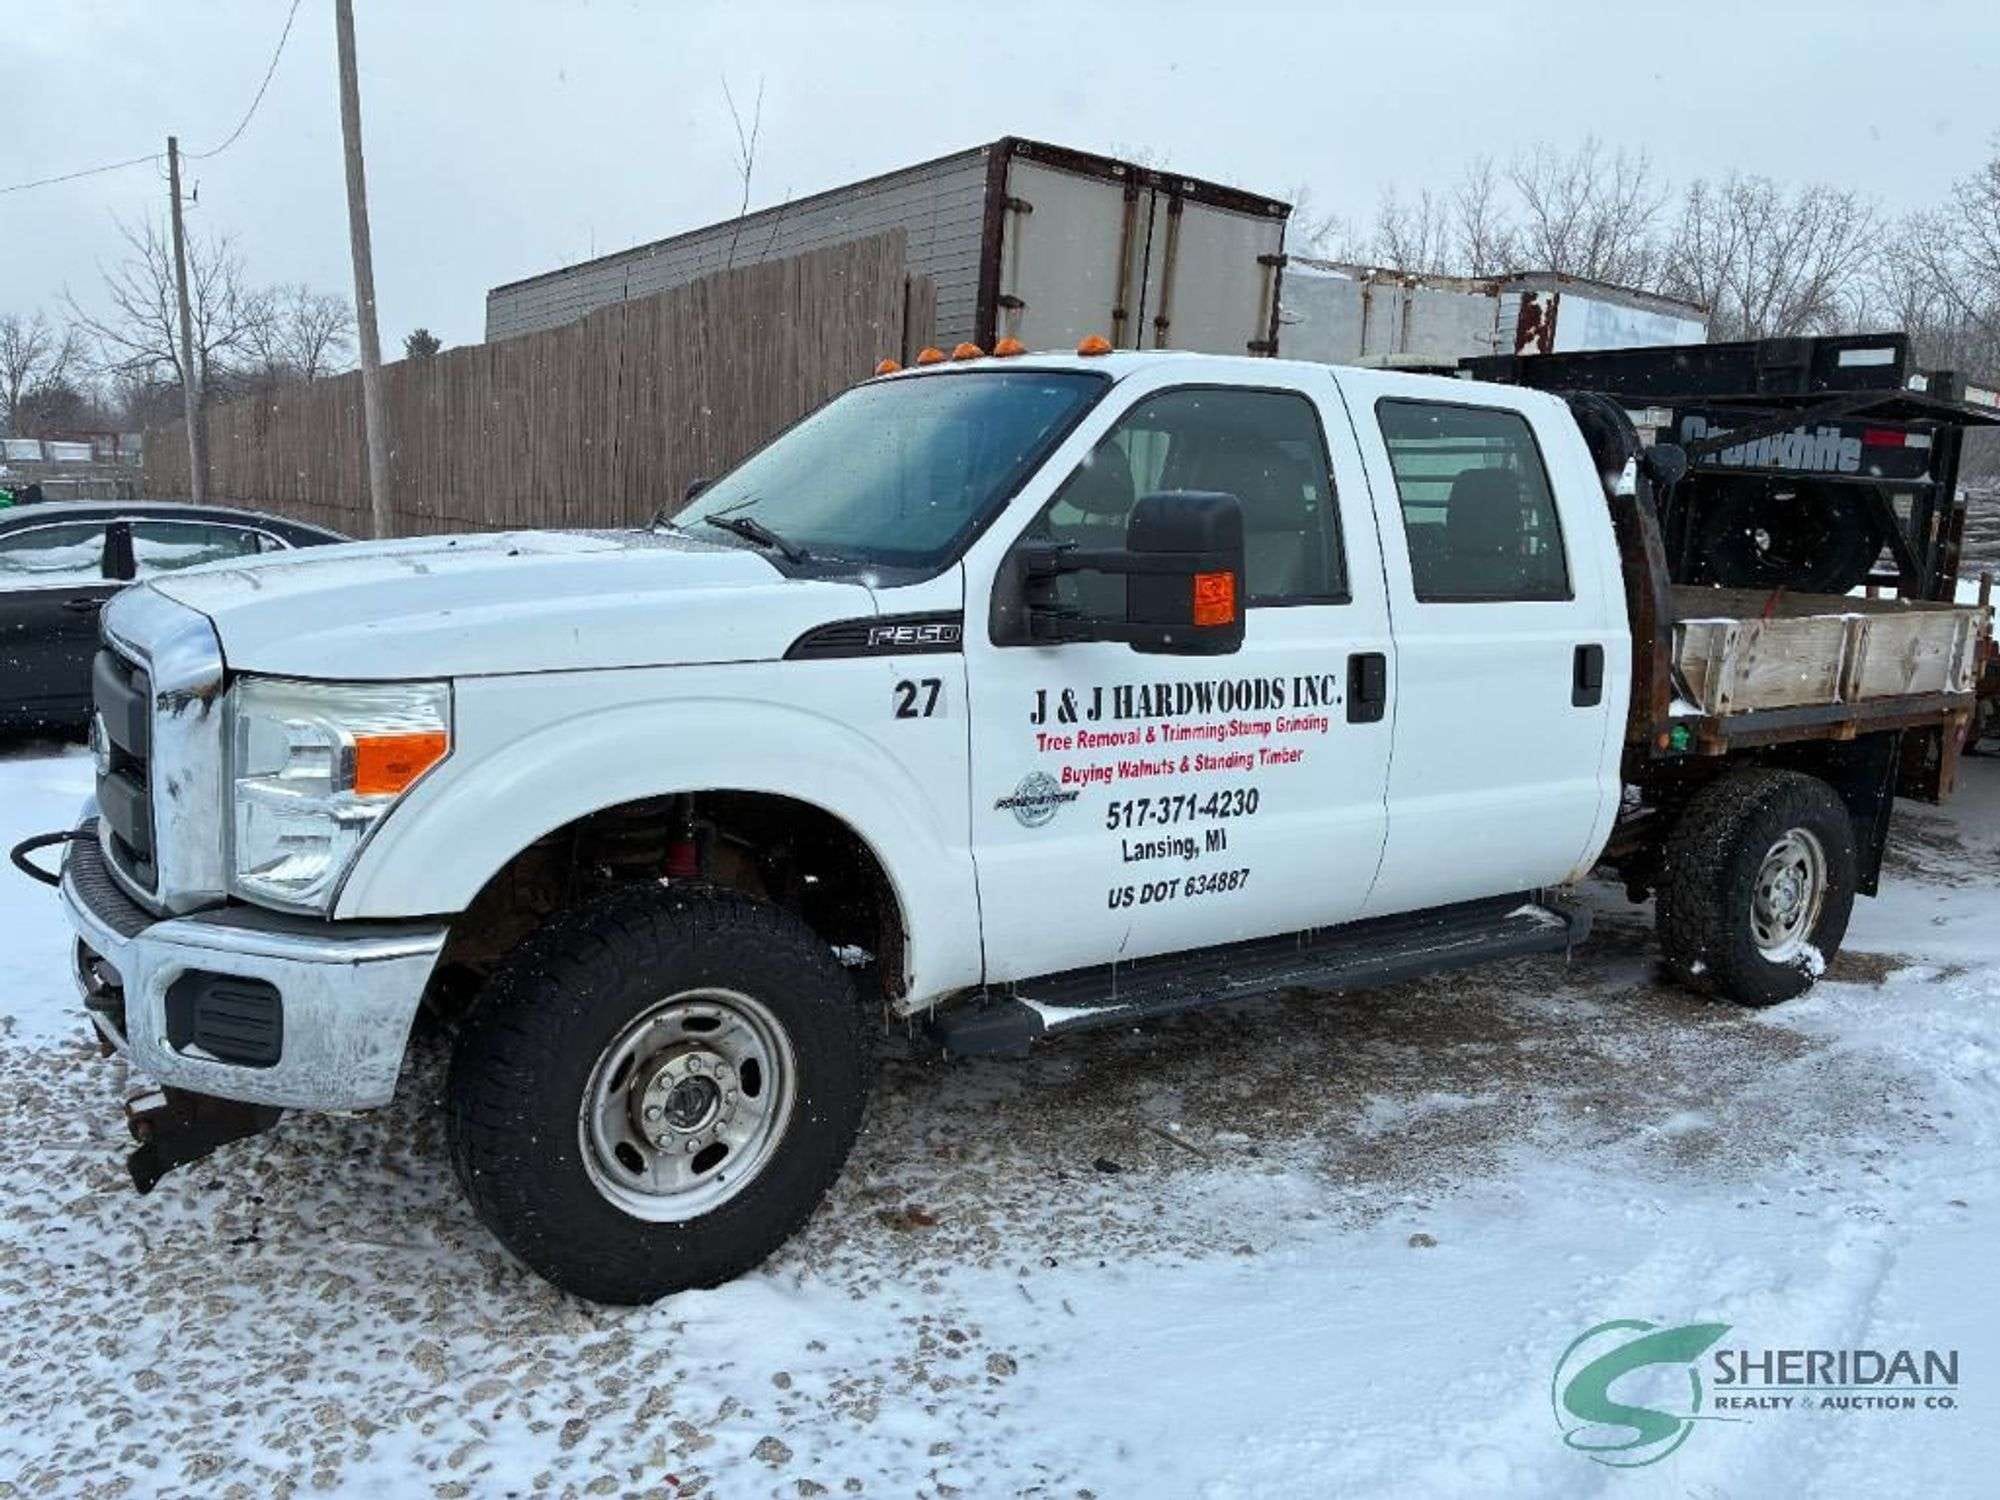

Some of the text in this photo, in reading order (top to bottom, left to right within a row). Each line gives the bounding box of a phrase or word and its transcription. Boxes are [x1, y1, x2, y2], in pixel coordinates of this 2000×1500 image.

[895, 678, 942, 719] 27
[1030, 674, 1343, 725] J & J HARDWOODS INC.
[1036, 733, 1073, 752] Tree
[1077, 727, 1141, 749] Removal
[1145, 725, 1156, 743] &
[1276, 713, 1329, 734] Grinding
[1061, 747, 1304, 788] Buying Walnuts & Standing Timber
[1106, 787, 1260, 830] 517-371-4230
[1122, 827, 1227, 863] Lansing, MI
[1108, 868, 1250, 909] US DOT 634887
